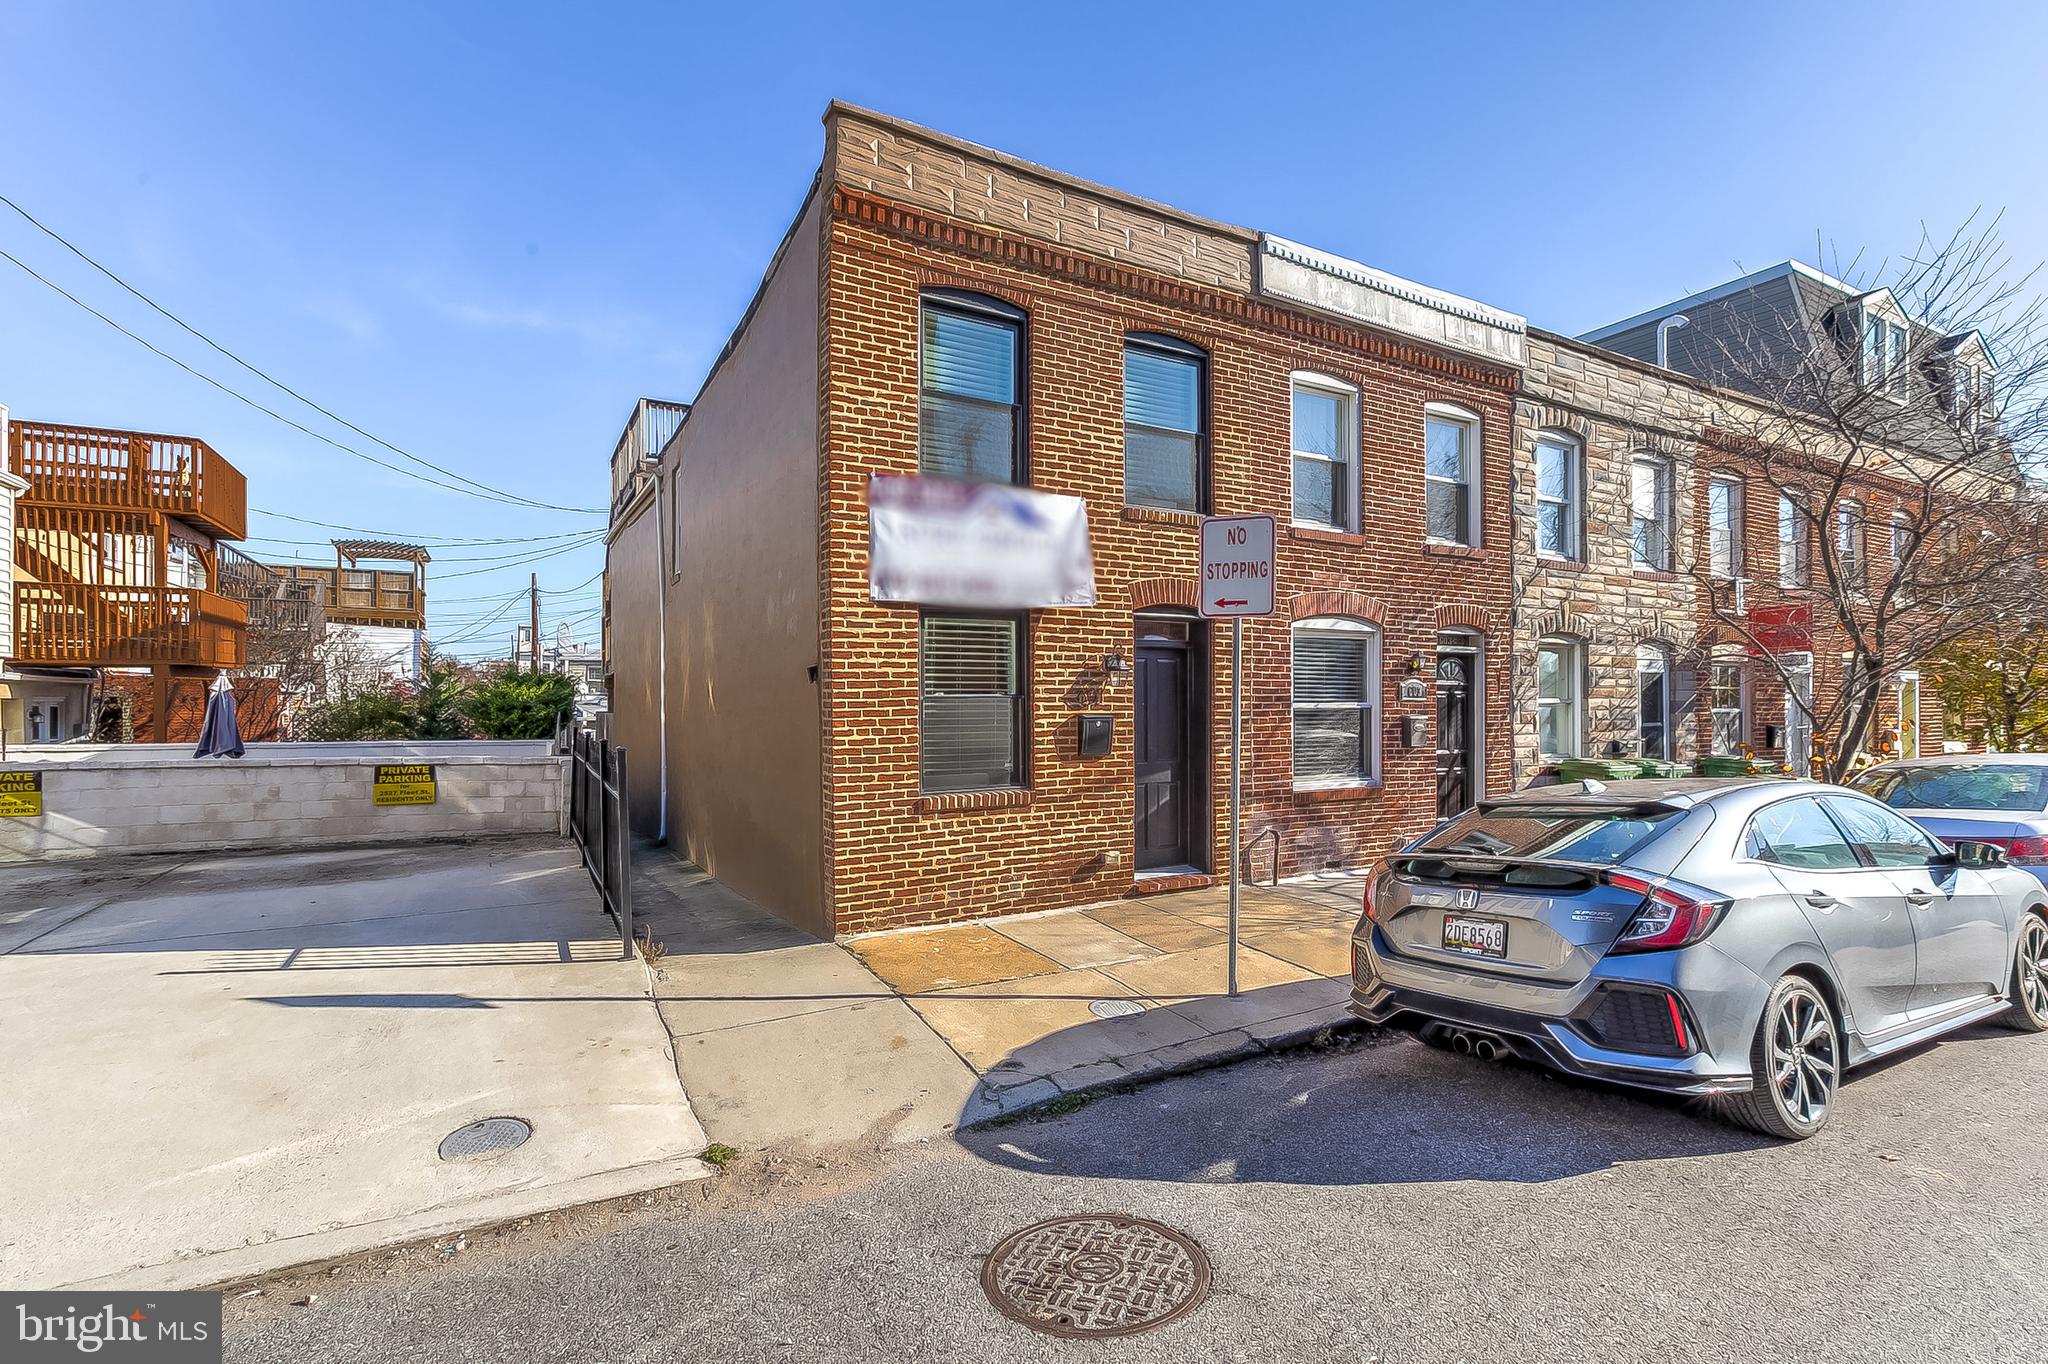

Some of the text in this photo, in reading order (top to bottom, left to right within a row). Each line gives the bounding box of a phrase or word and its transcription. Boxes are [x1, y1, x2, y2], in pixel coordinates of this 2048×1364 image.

[1227, 527, 1247, 545] NO
[1207, 560, 1268, 580] STOPPING
[380, 766, 430, 774] PRIVATE
[378, 774, 431, 783] PARKING
